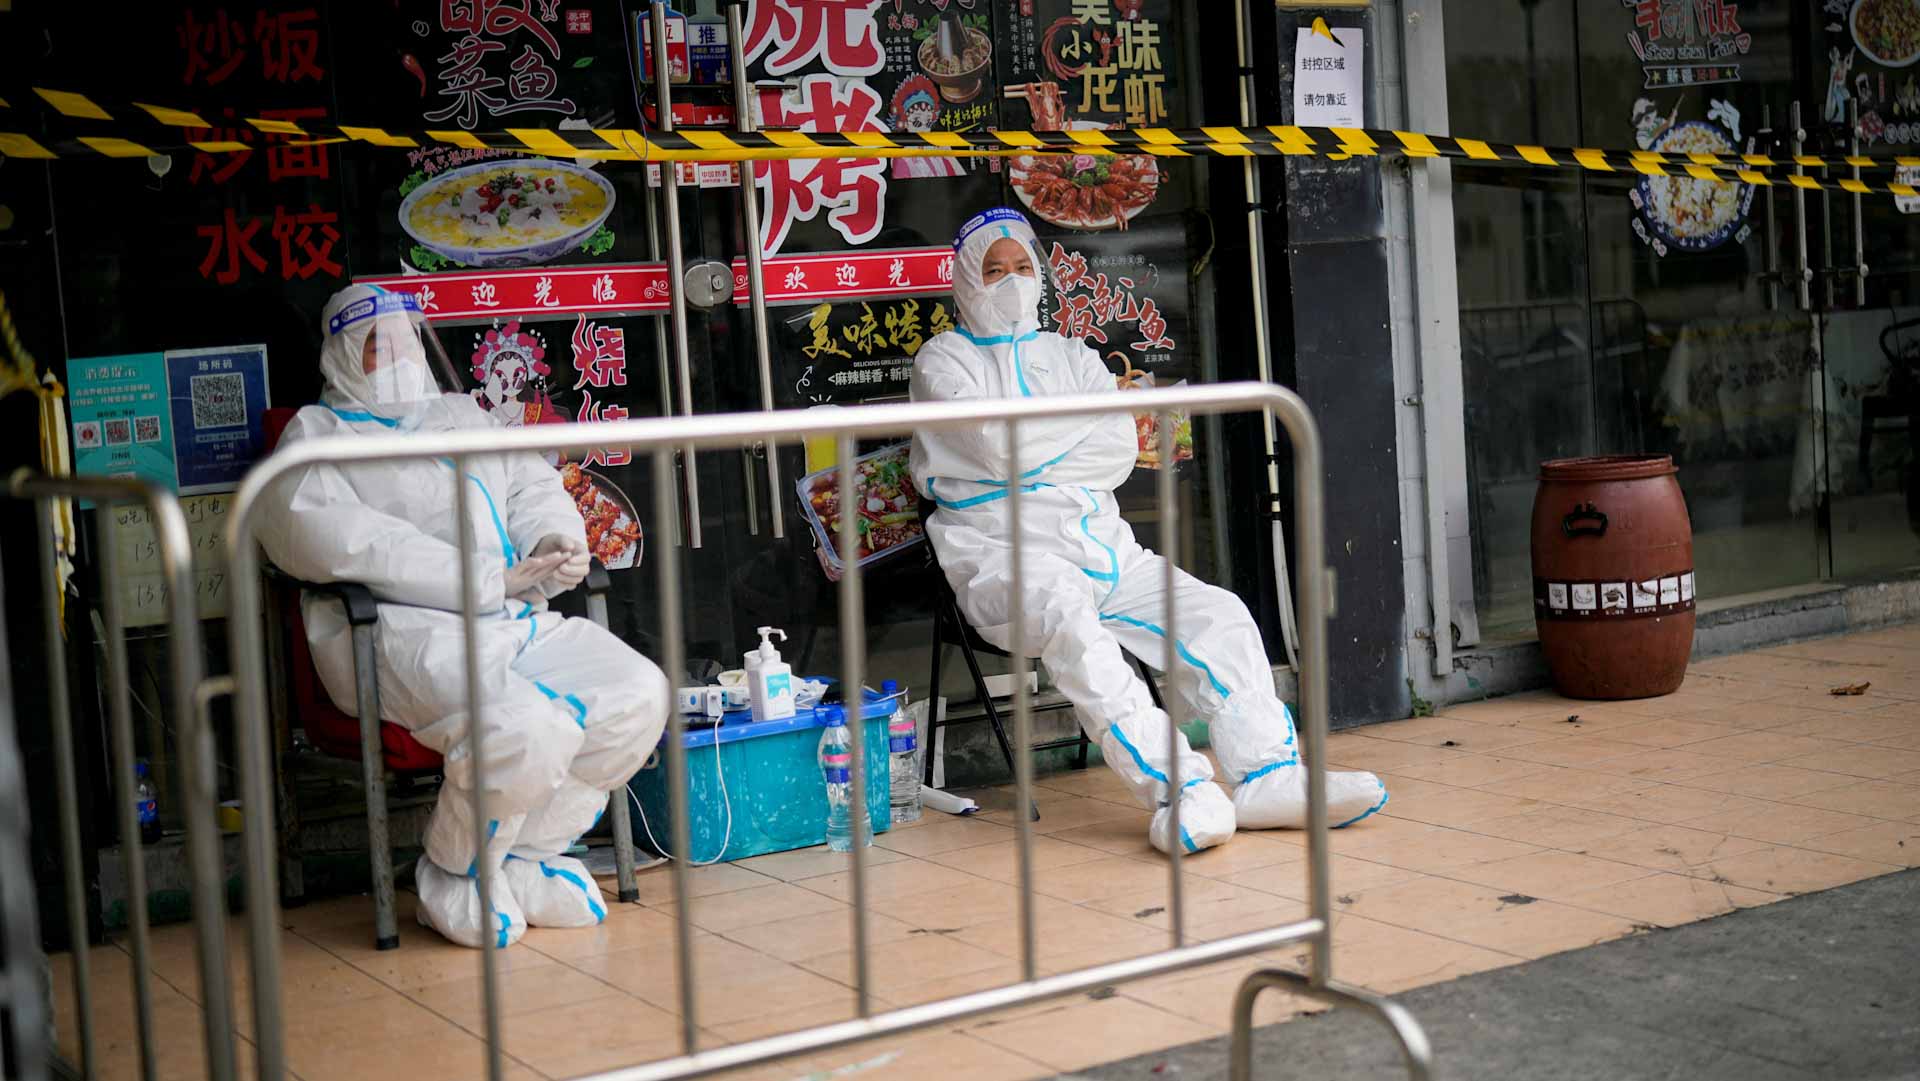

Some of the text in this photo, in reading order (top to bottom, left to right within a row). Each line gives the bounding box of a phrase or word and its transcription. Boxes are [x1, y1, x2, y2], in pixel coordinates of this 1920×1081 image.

[887, 12, 919, 31] 火锅
[698, 25, 716, 44] 推
[177, 7, 326, 85] 炒饭
[1302, 57, 1345, 71] 封控区域
[1304, 92, 1348, 106] 请勿靠近
[183, 107, 331, 185] 炒面
[196, 203, 345, 285] 水饺
[415, 274, 617, 312] 欢迎光临
[198, 359, 232, 371] 场所码
